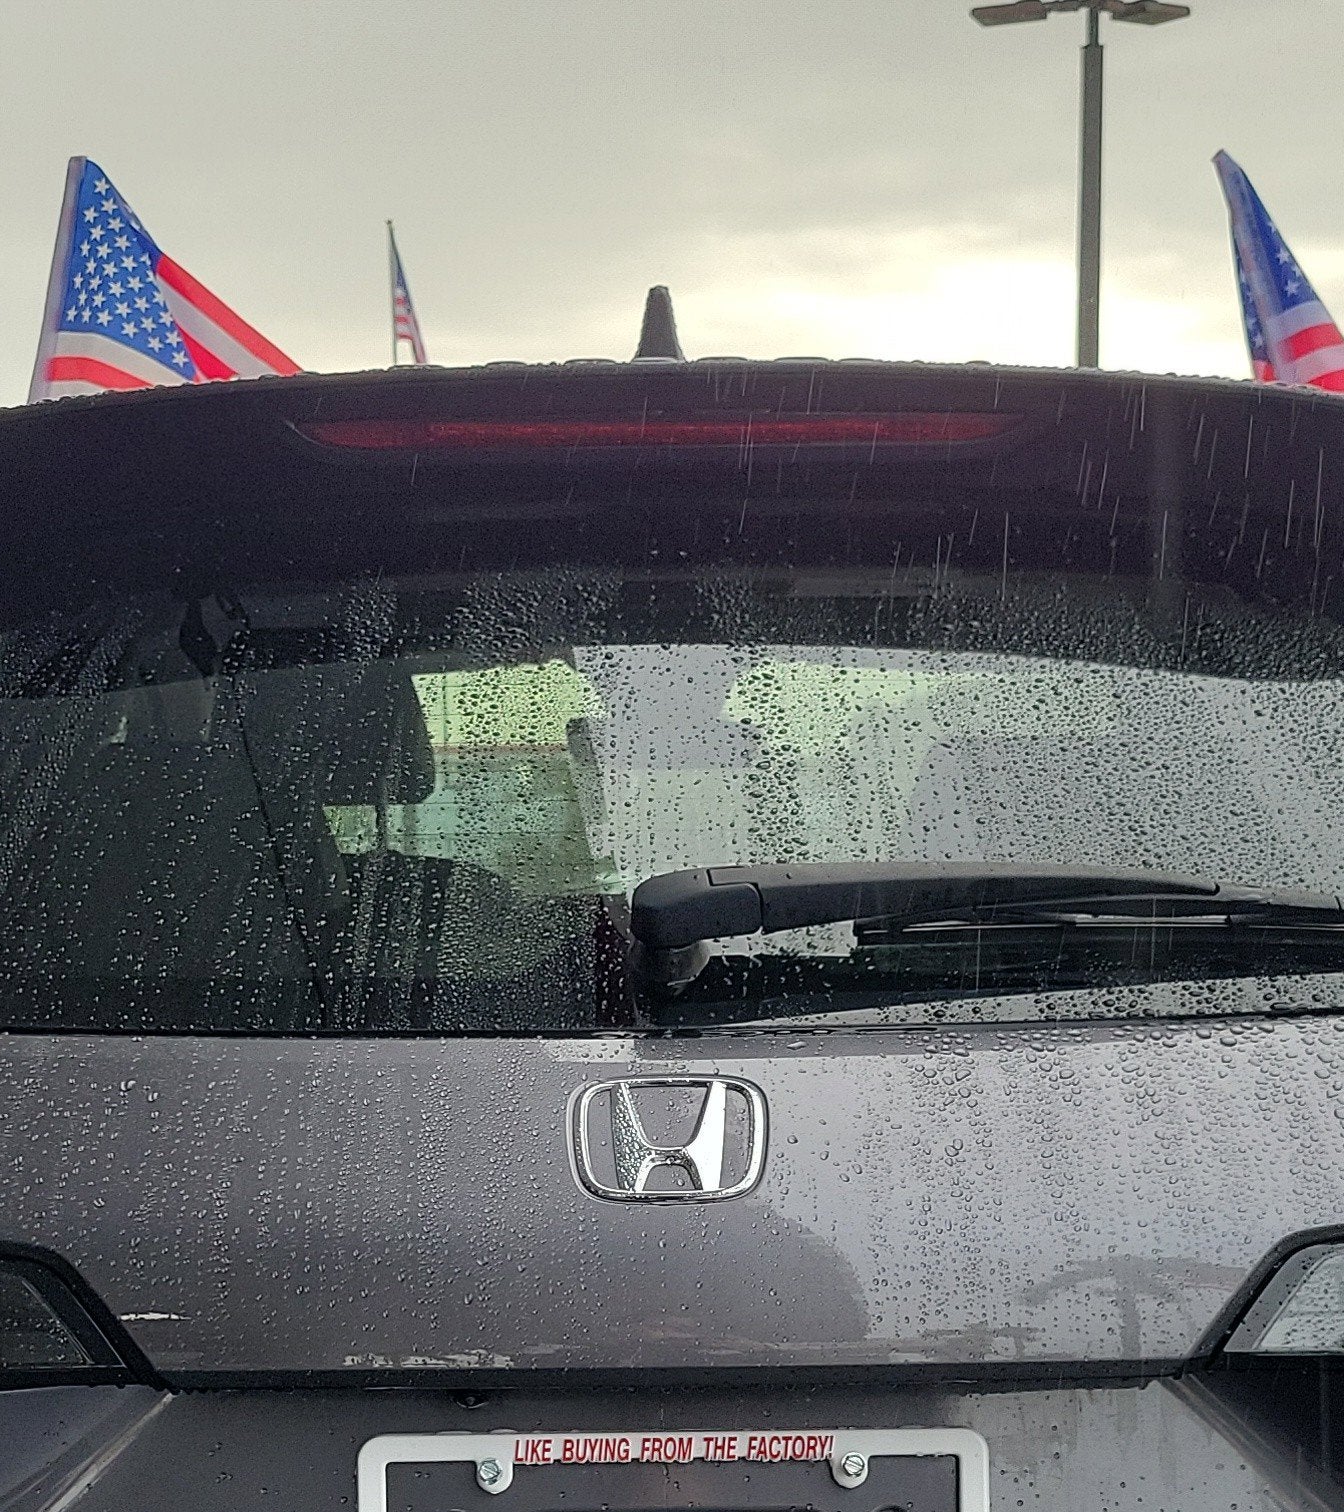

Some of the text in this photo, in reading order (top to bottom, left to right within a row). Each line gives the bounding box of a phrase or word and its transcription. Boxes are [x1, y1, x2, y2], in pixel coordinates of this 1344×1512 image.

[514, 1435, 835, 1462] LIKE BUYING FROM THE FACTORY!
